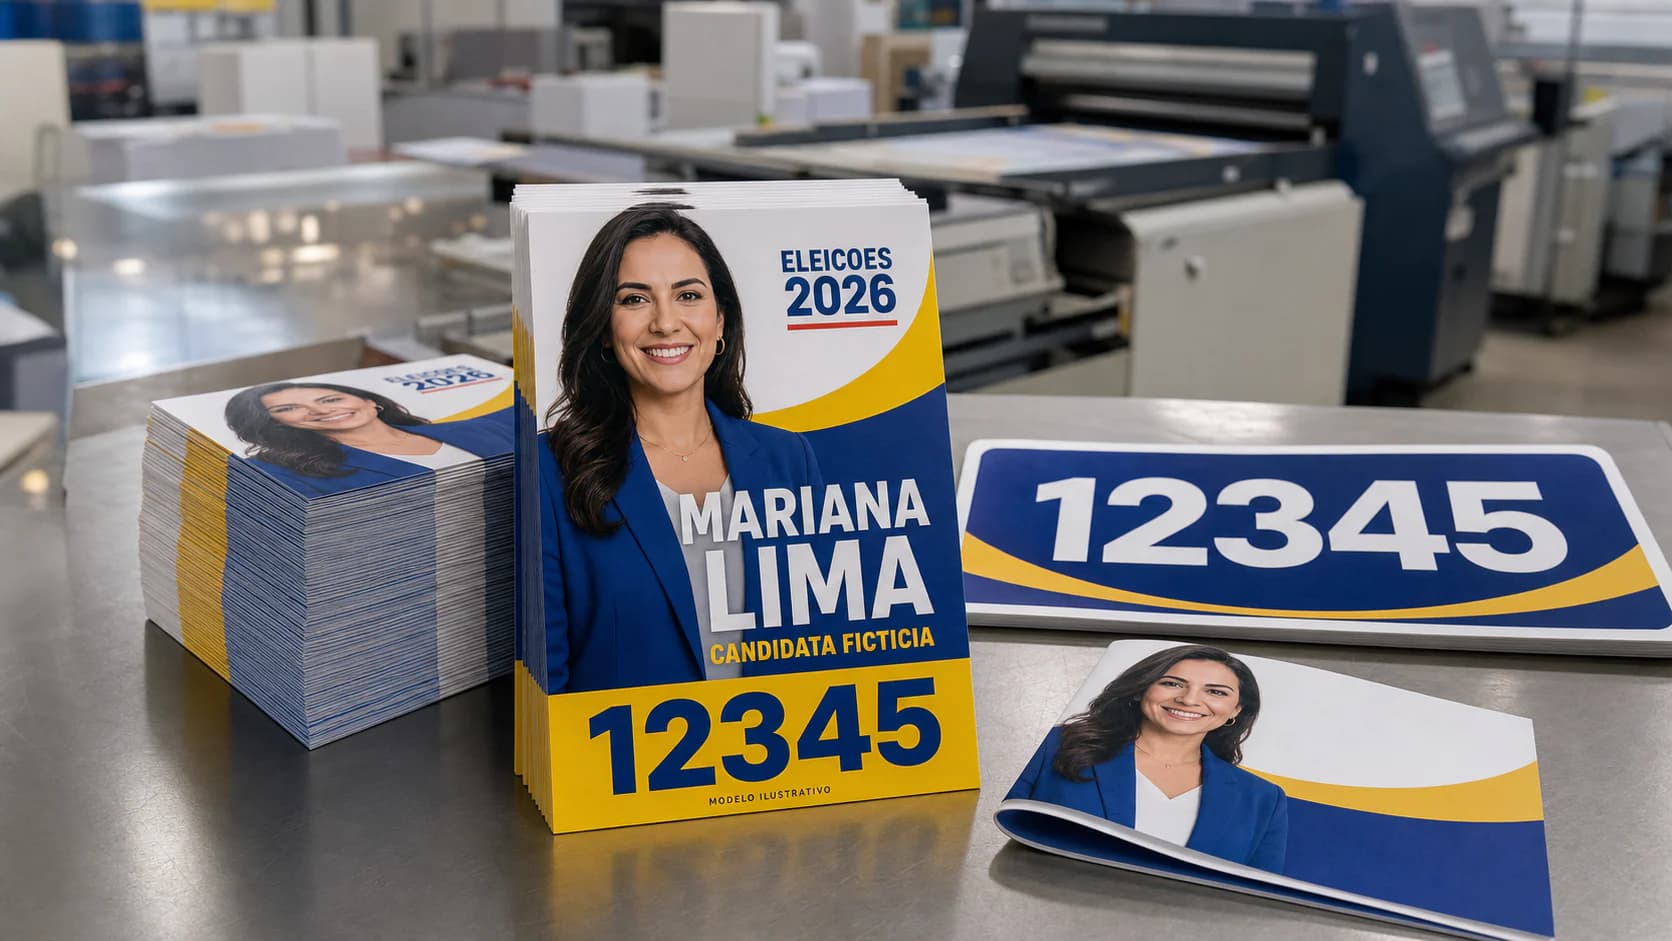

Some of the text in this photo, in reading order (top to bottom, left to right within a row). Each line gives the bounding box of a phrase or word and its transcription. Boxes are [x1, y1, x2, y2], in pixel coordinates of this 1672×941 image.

[781, 247, 893, 272] ELEICOES
[785, 273, 897, 316] 2026
[402, 372, 495, 391] 2026
[680, 478, 931, 544] MARIANA
[1036, 477, 1568, 573] 12345
[705, 536, 935, 632] LIMA
[710, 626, 935, 665] CANDIDATA FICTICIA
[589, 677, 942, 795] 12345
[709, 785, 831, 806] MODELO ILUSTRATIVO
